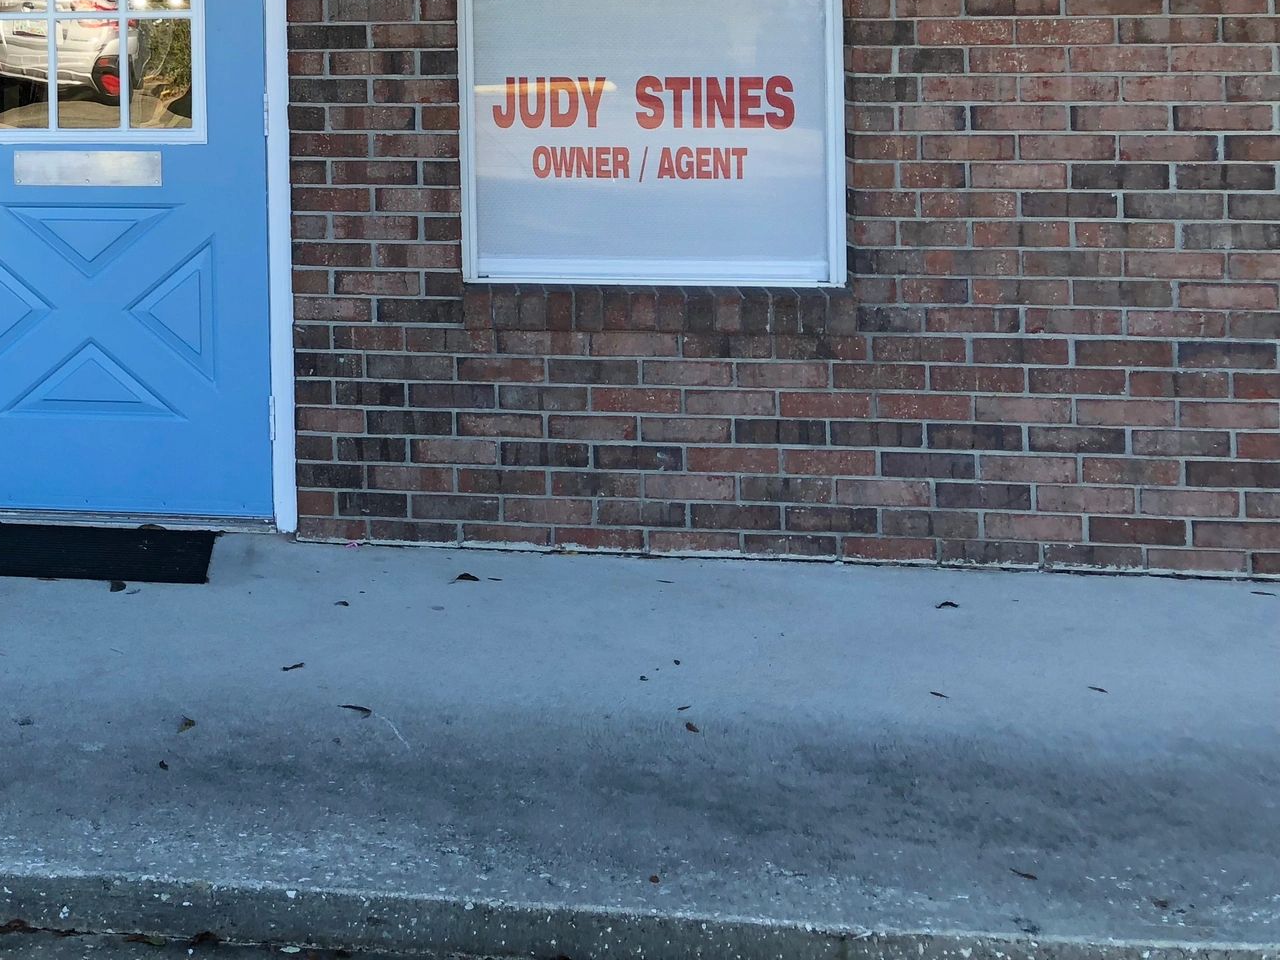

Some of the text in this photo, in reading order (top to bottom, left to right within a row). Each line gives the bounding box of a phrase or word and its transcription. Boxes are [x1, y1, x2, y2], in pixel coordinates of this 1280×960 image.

[492, 75, 795, 130] JUDY STINES
[532, 145, 630, 180] OWNER
[656, 145, 749, 180] AGENT
